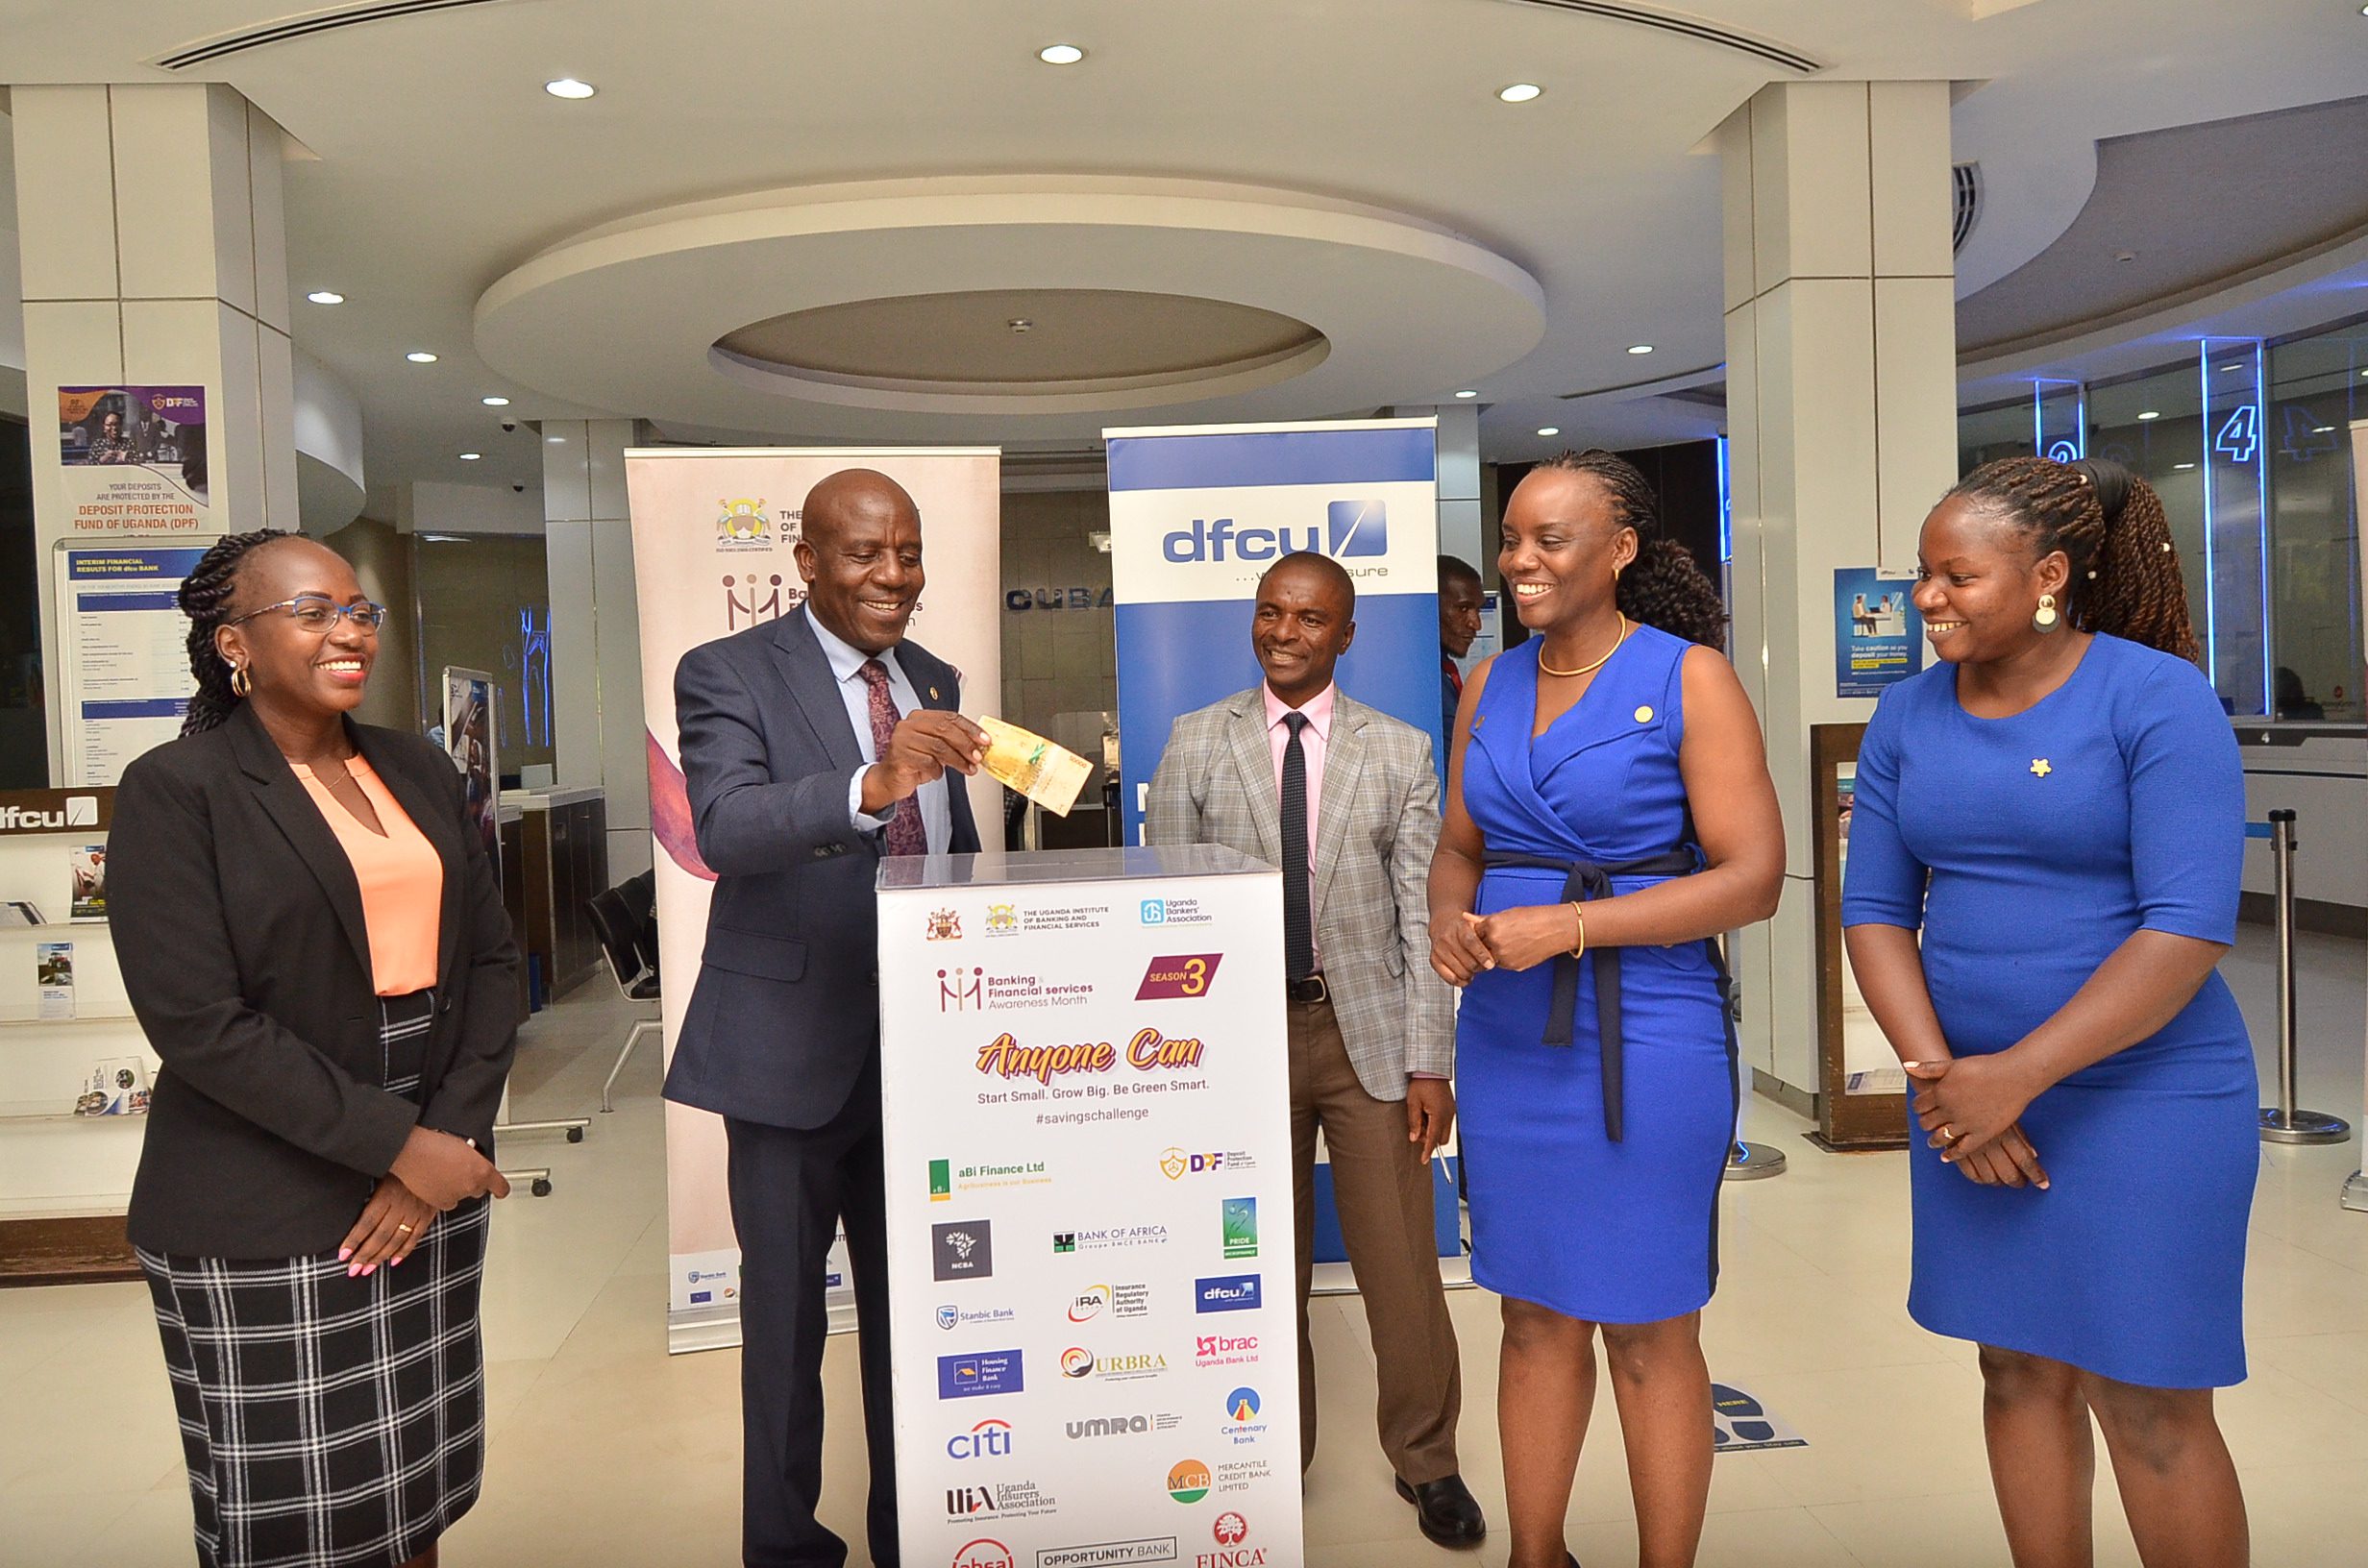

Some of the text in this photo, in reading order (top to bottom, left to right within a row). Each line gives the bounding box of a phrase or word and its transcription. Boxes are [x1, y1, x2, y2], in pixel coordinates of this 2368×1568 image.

[2215, 405, 2257, 462] 4
[79, 503, 193, 515] DEPOSIT PROTECTION
[74, 518, 199, 530] FUND OF UGANDA (DPF)
[780, 523, 797, 531] OF
[1163, 519, 1320, 563] dfcu
[1165, 898, 1197, 908] Uganda
[1073, 906, 1109, 915] INSTITUTE
[1166, 906, 1199, 916] Bankers'
[1166, 914, 1213, 923] Association
[988, 975, 1036, 987] Banking
[1149, 958, 1206, 994] SEASON 3
[988, 984, 1094, 998] Financial services
[989, 993, 1088, 1010] Awareness Month
[975, 1027, 1205, 1087] Anyone Can
[977, 1079, 1210, 1104] Start Small. Grow Big. Be Green Smart.
[1036, 1108, 1149, 1125] #savingschallenge
[1190, 1152, 1223, 1172] DPF
[979, 1164, 1024, 1177] Finance
[1026, 1161, 1045, 1173] Ltd
[1077, 1225, 1168, 1241] BANK OF AFRICA
[951, 1261, 974, 1269] NCBA
[1115, 1289, 1149, 1299] Regulatory
[1204, 1287, 1240, 1300] dfcu
[960, 1311, 992, 1321] Stanbic
[993, 1308, 1015, 1318] Bank
[1123, 1305, 1147, 1313] Uganda
[1220, 1335, 1258, 1351] brac
[981, 1357, 1008, 1365] Housing
[1096, 1354, 1168, 1373] URBRA
[1196, 1354, 1259, 1367] Uganda Bank Ltd
[982, 1365, 1007, 1374] Finance
[982, 1373, 999, 1382] Bank
[1221, 1424, 1267, 1435] Centenary
[947, 1427, 1010, 1459] citi
[1233, 1434, 1255, 1444] Bank
[1218, 1460, 1268, 1472] MERCANTILE
[1168, 1473, 1209, 1490] MCB
[1219, 1470, 1271, 1482] CREDIT BANK
[997, 1481, 1036, 1493] Uganda
[1219, 1482, 1248, 1492] LIMITED
[997, 1490, 1040, 1502] Insurers
[997, 1497, 1055, 1510] Association
[1044, 1543, 1171, 1566] OPPORTUNITY BANK
